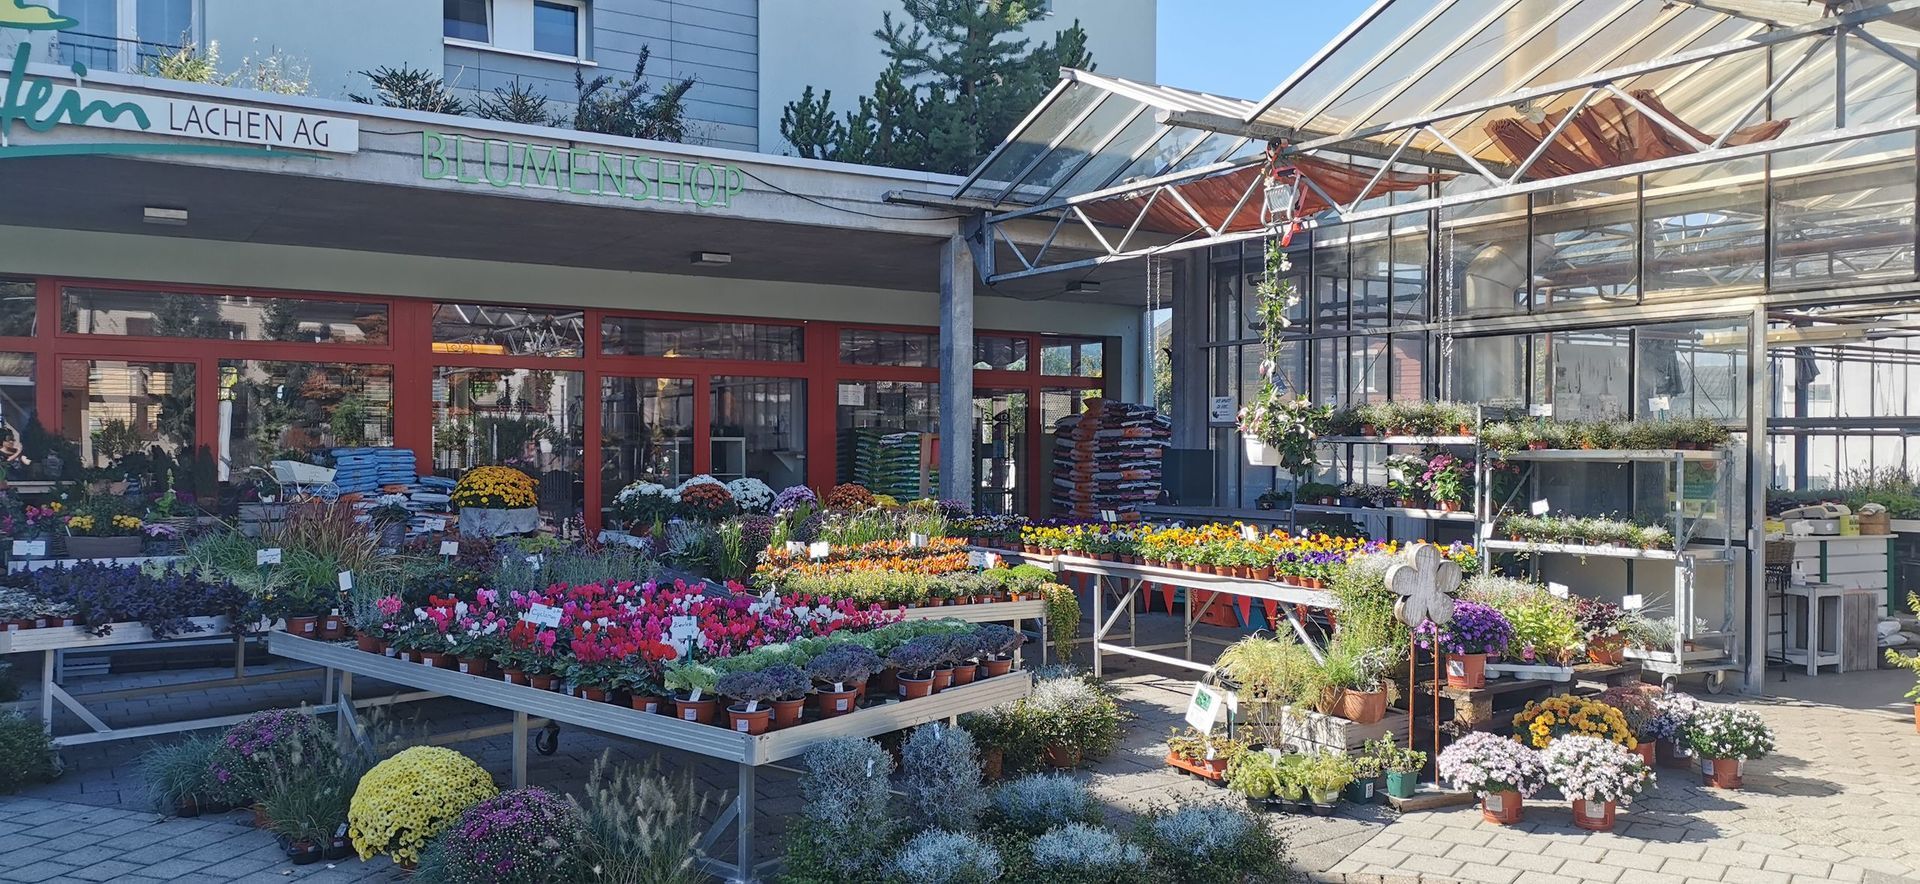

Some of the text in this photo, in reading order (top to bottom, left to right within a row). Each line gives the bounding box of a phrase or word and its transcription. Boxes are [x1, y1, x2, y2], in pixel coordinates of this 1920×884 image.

[0, 42, 330, 147] tein LACHEN AG
[422, 130, 744, 208] BLUMENSHOP
